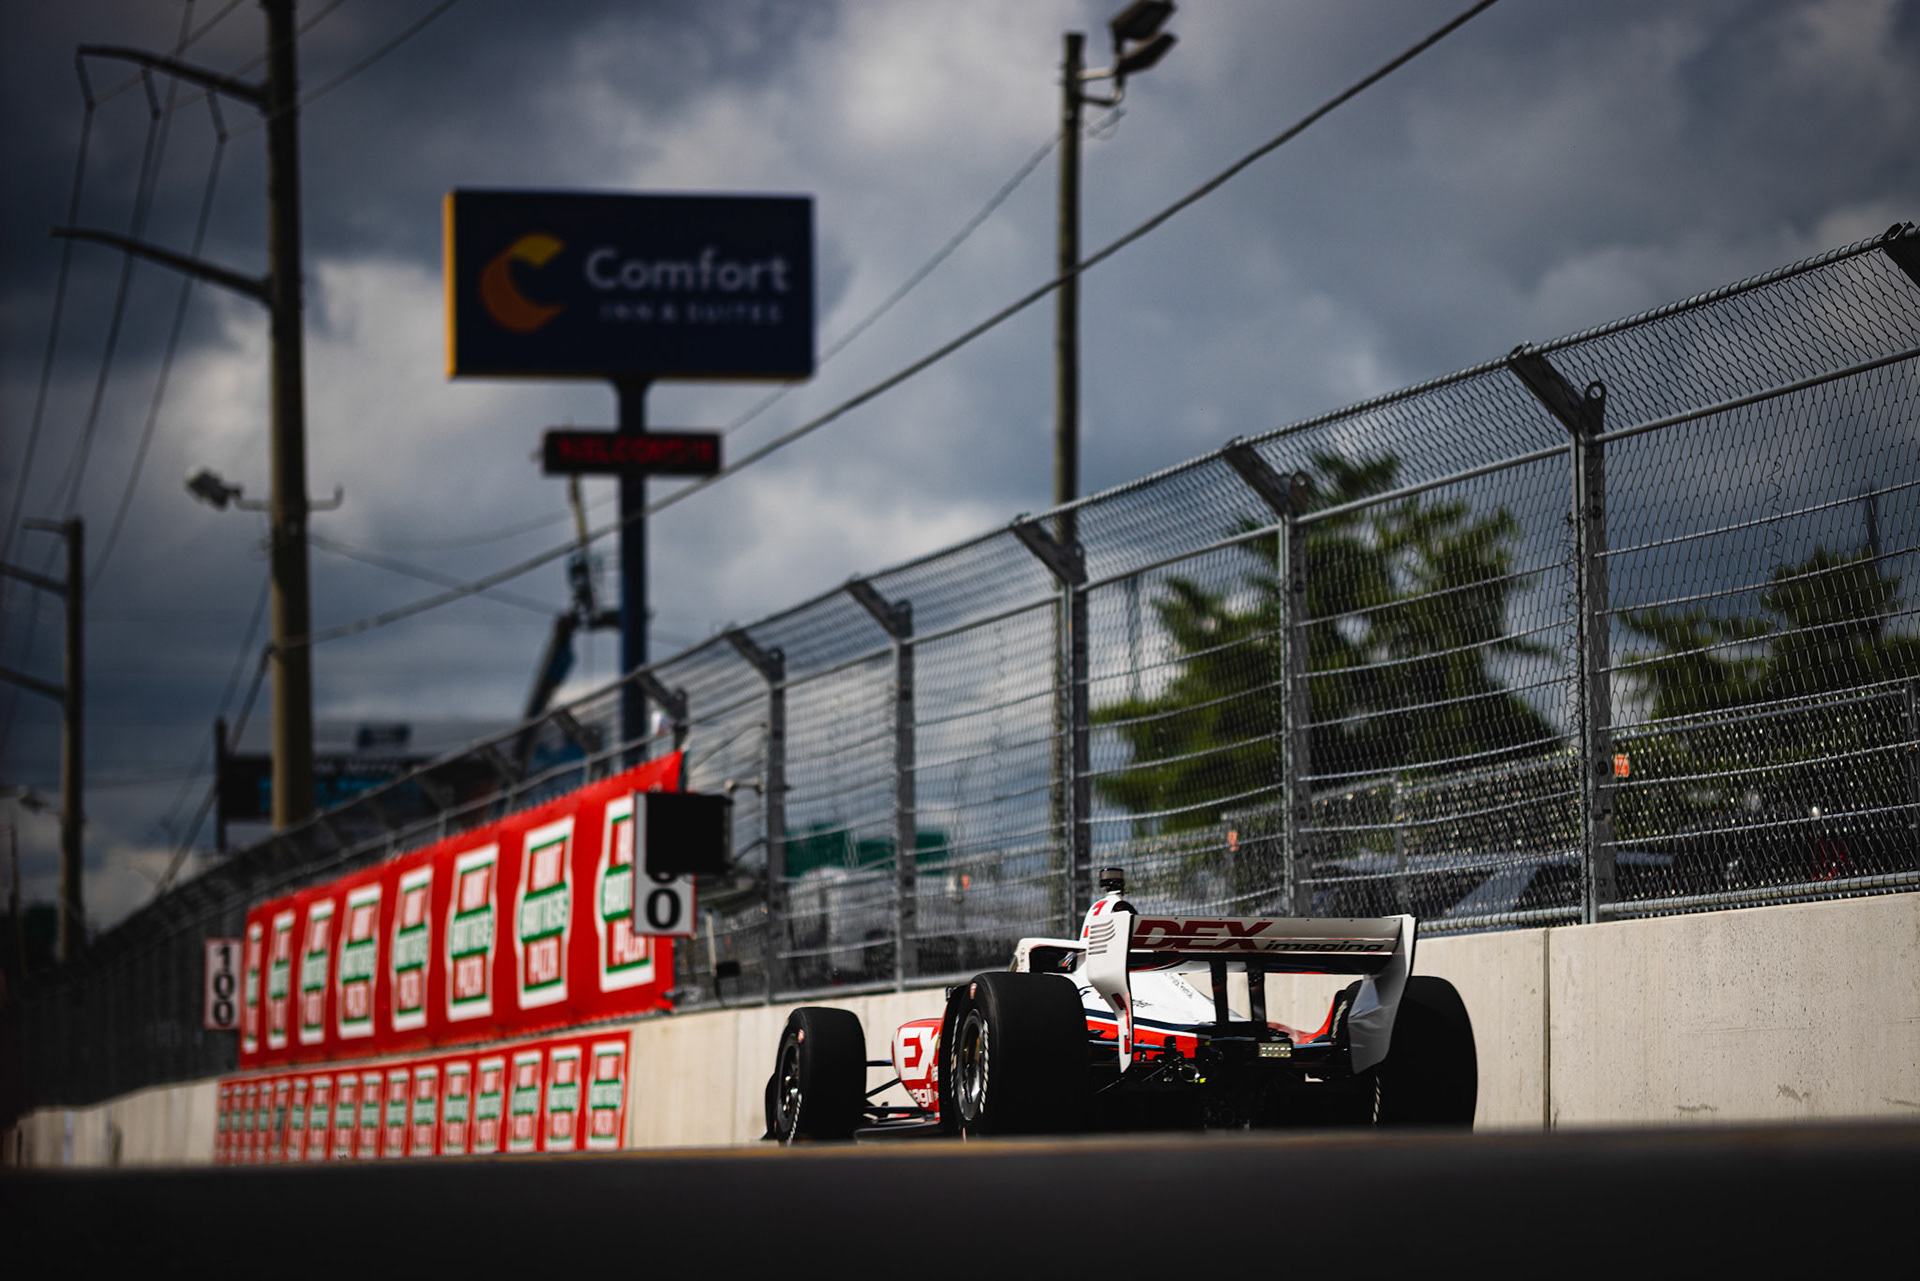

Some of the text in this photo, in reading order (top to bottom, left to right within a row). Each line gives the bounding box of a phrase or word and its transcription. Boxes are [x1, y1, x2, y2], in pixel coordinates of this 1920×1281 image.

[583, 244, 792, 292] Comfort
[646, 872, 681, 930] 0
[1131, 919, 1274, 950] DEX
[1264, 940, 1384, 952] imaging
[213, 945, 236, 1027] 100
